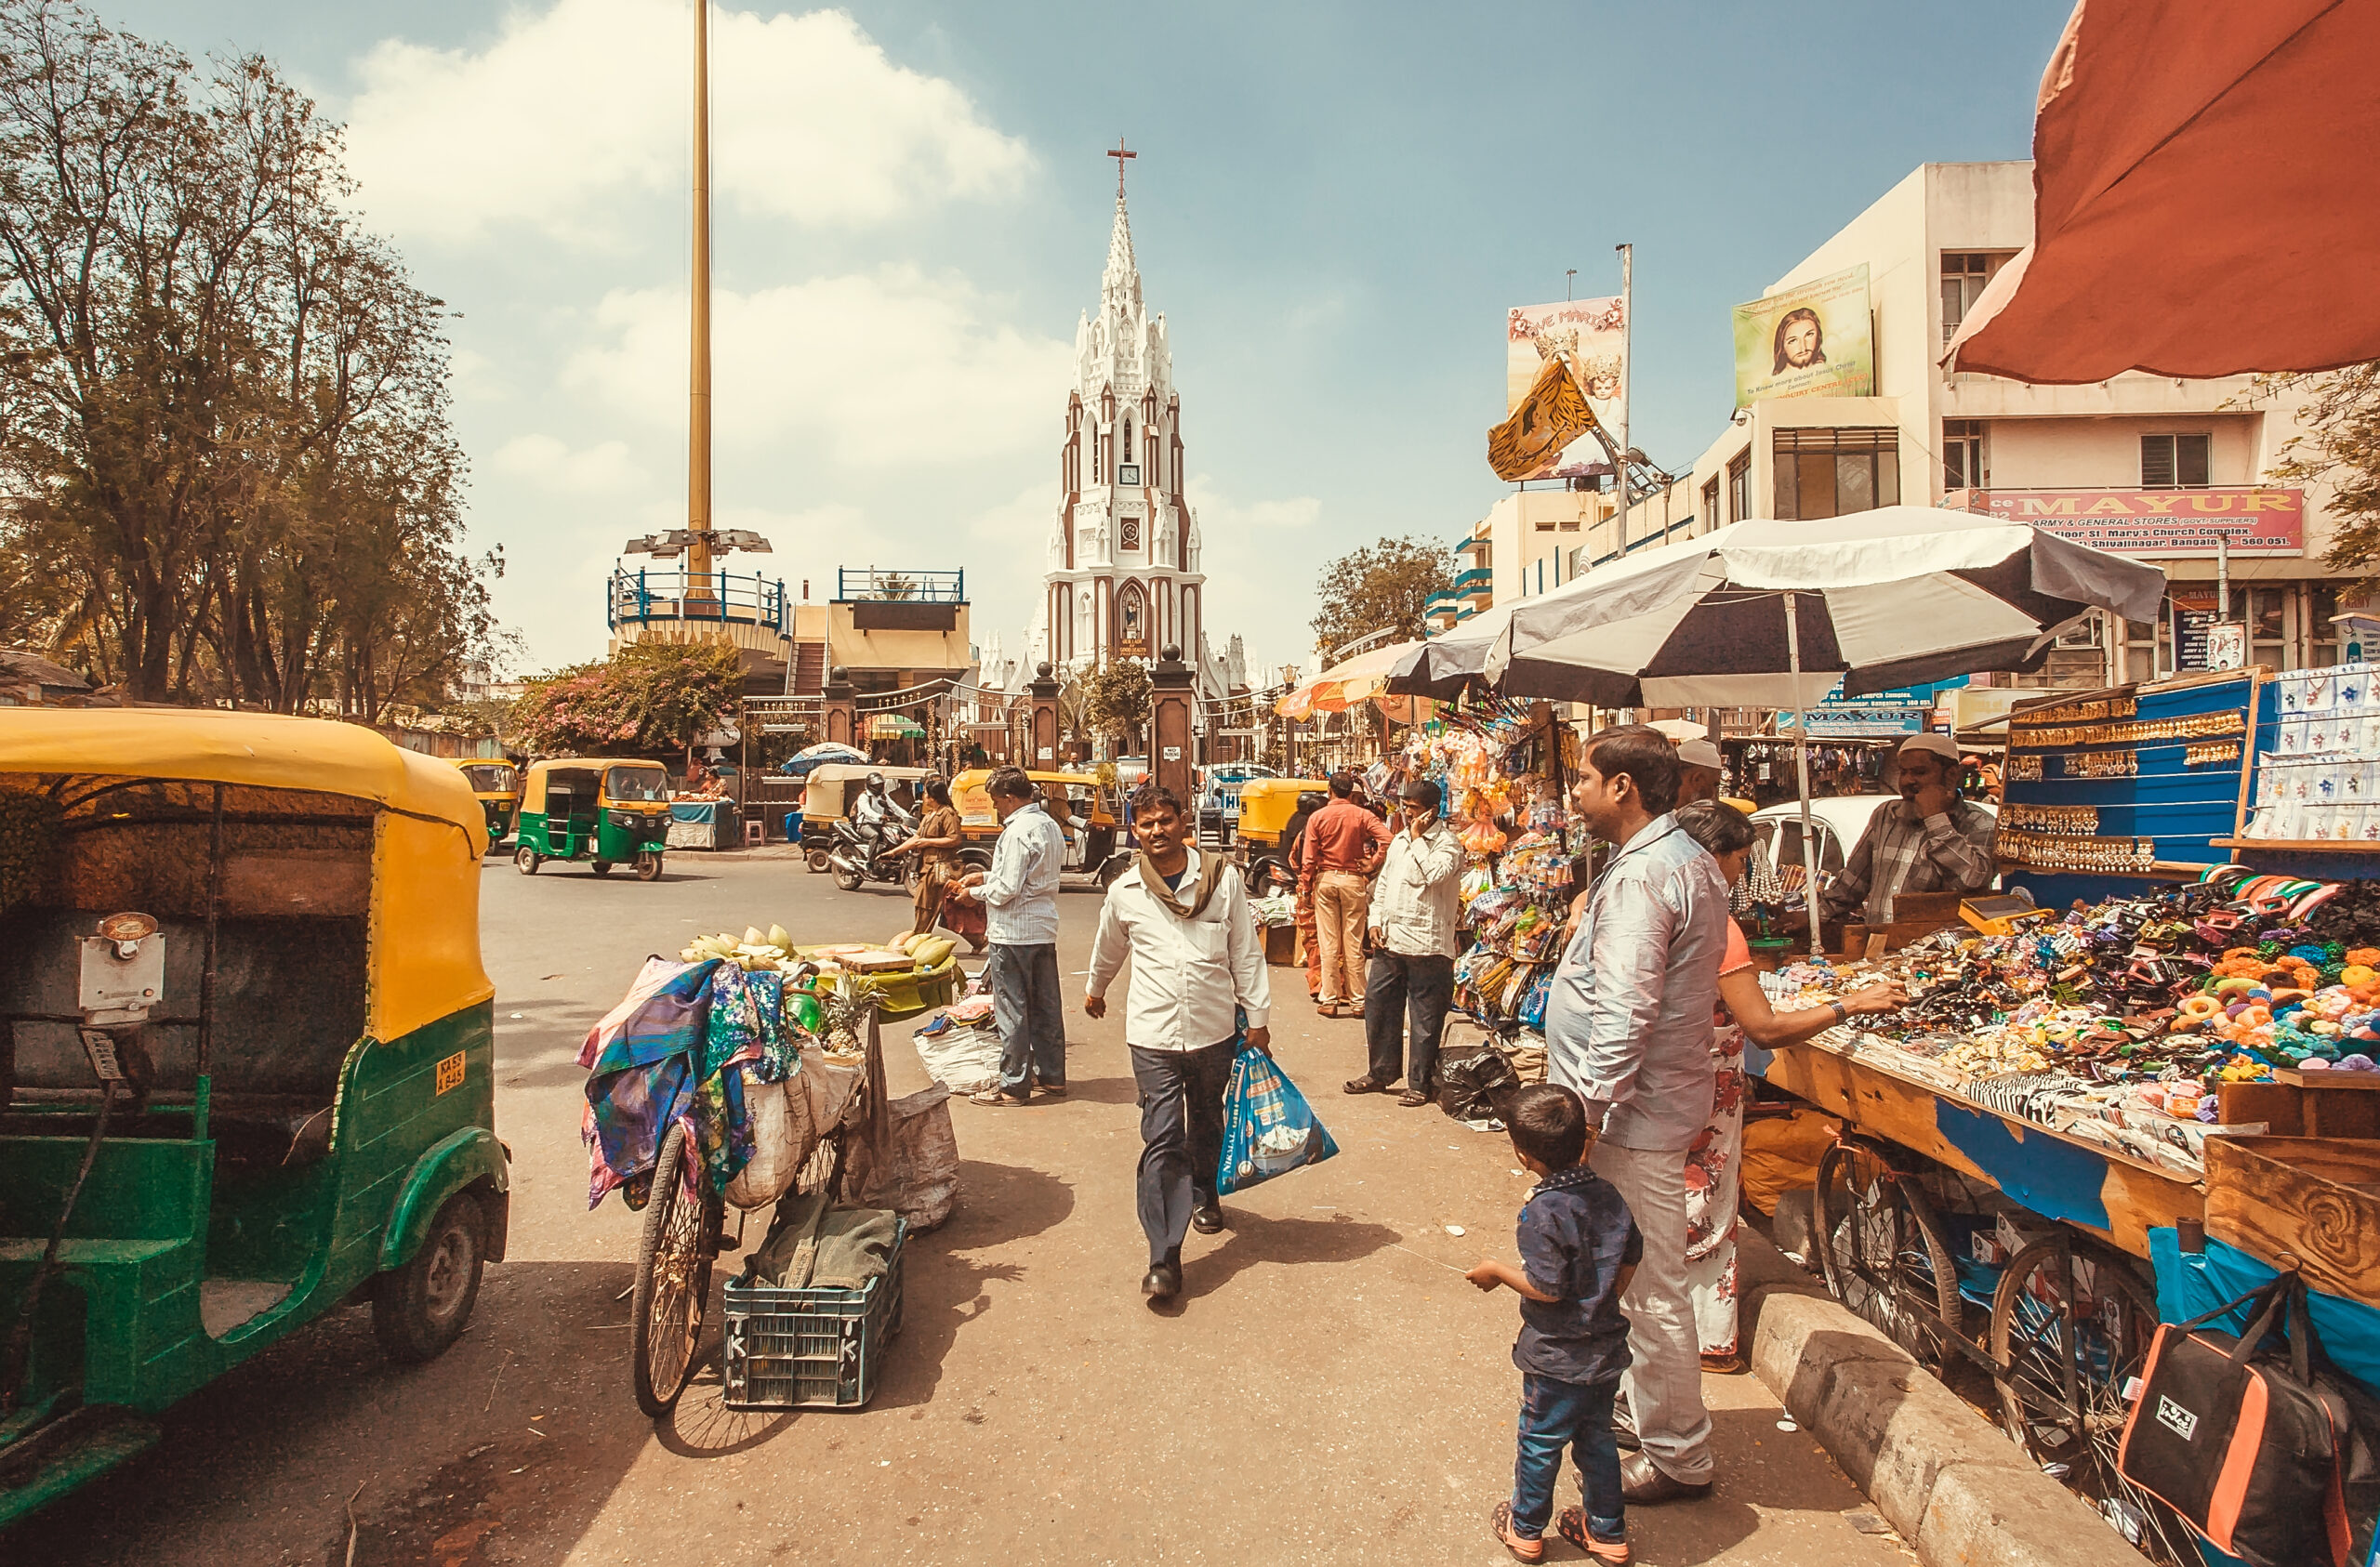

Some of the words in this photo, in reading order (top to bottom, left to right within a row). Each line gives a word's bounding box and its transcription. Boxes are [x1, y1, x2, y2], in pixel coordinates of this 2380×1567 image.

[1793, 372, 1814, 382] about
[2017, 494, 2296, 516] MAYUR
[2032, 519, 2064, 528] ARMY
[2066, 519, 2075, 527] &
[2077, 517, 2130, 527] GENERAL
[2133, 517, 2177, 526] STORES
[2152, 528, 2195, 536] Church
[1805, 711, 1921, 722] MAYUR
